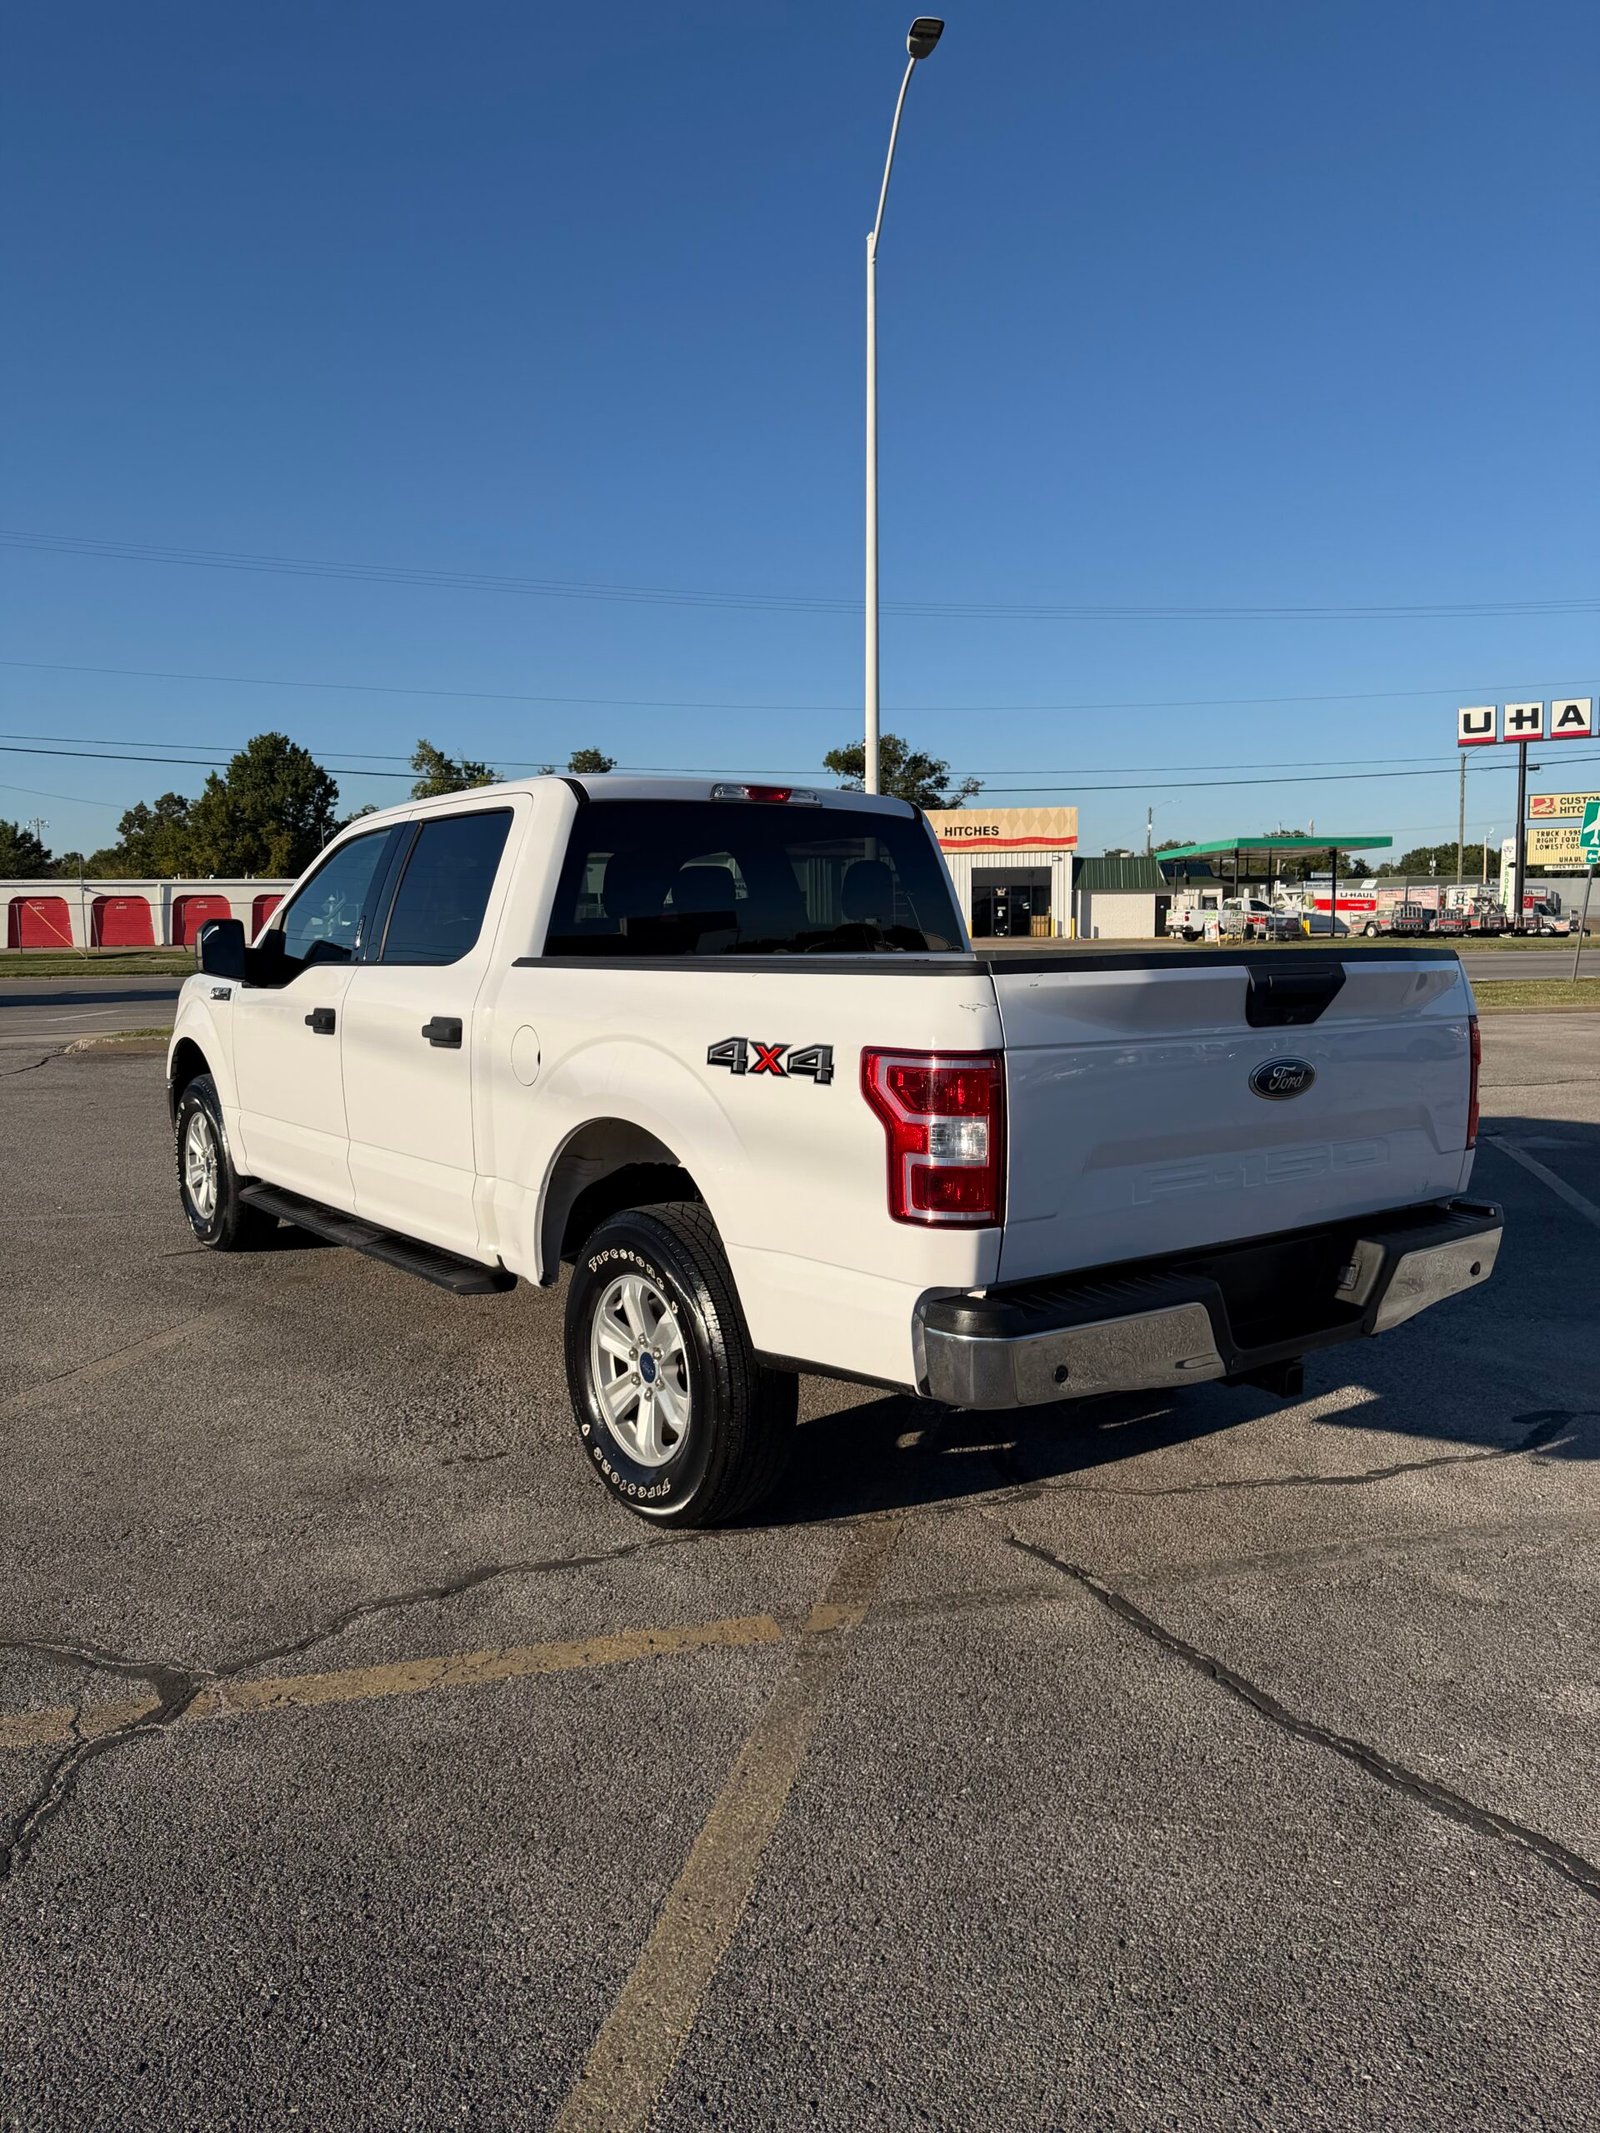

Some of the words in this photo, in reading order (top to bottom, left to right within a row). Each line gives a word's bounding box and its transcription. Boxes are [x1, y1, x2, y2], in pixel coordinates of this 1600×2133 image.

[1560, 805, 1585, 814] HITC
[944, 825, 1000, 837] HITCHES
[1268, 1066, 1305, 1091] Ford
